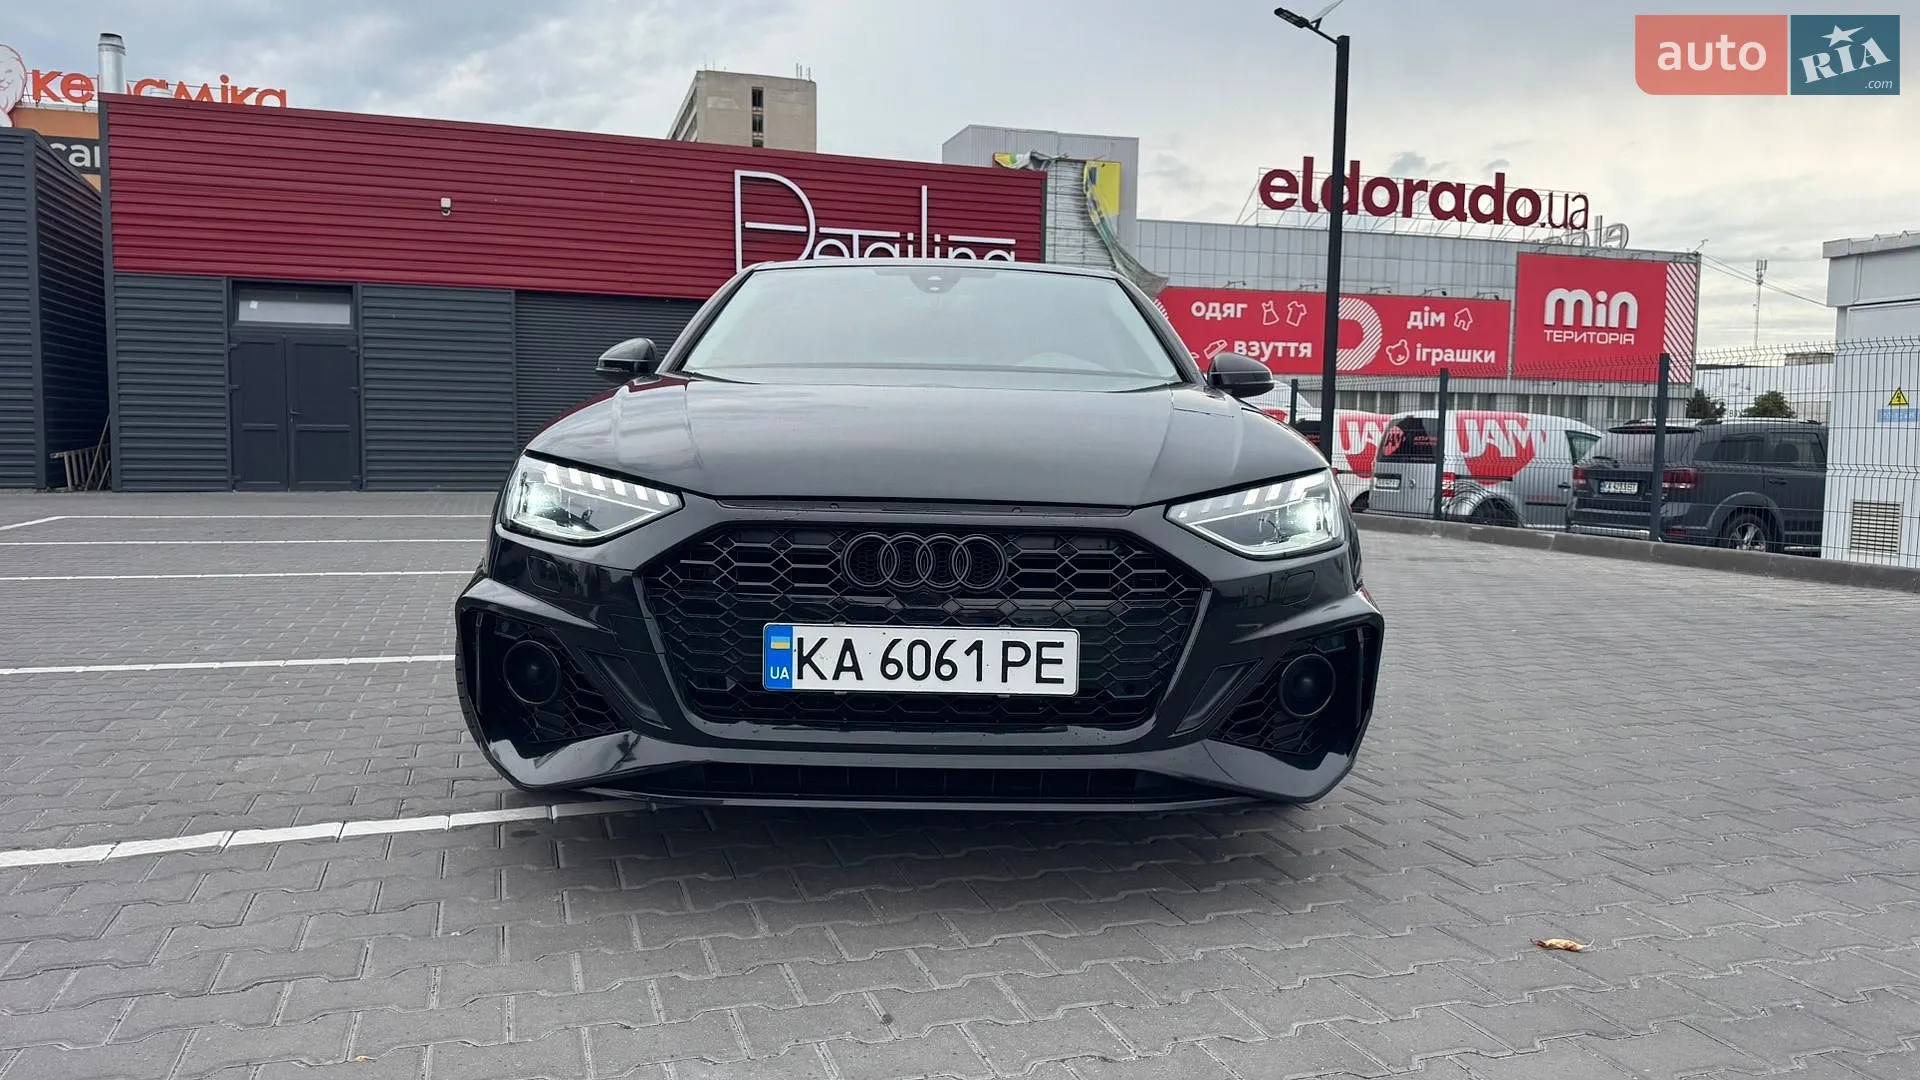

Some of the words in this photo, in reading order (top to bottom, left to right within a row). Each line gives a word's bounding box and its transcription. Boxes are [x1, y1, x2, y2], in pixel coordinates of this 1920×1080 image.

[1259, 156, 1589, 230] eldorado.ua
[1191, 301, 1248, 320] одяг
[1406, 306, 1446, 330] дім
[1543, 329, 1635, 345] ТЕРИТОРІЯ
[1233, 340, 1313, 362] взуття
[1415, 344, 1496, 366] іграшки
[1342, 419, 1388, 456] JA
[1456, 418, 1542, 459] JAM
[797, 637, 864, 681] KA
[880, 638, 984, 682] 6061
[1001, 640, 1065, 684] PE
[770, 667, 789, 680] UA
